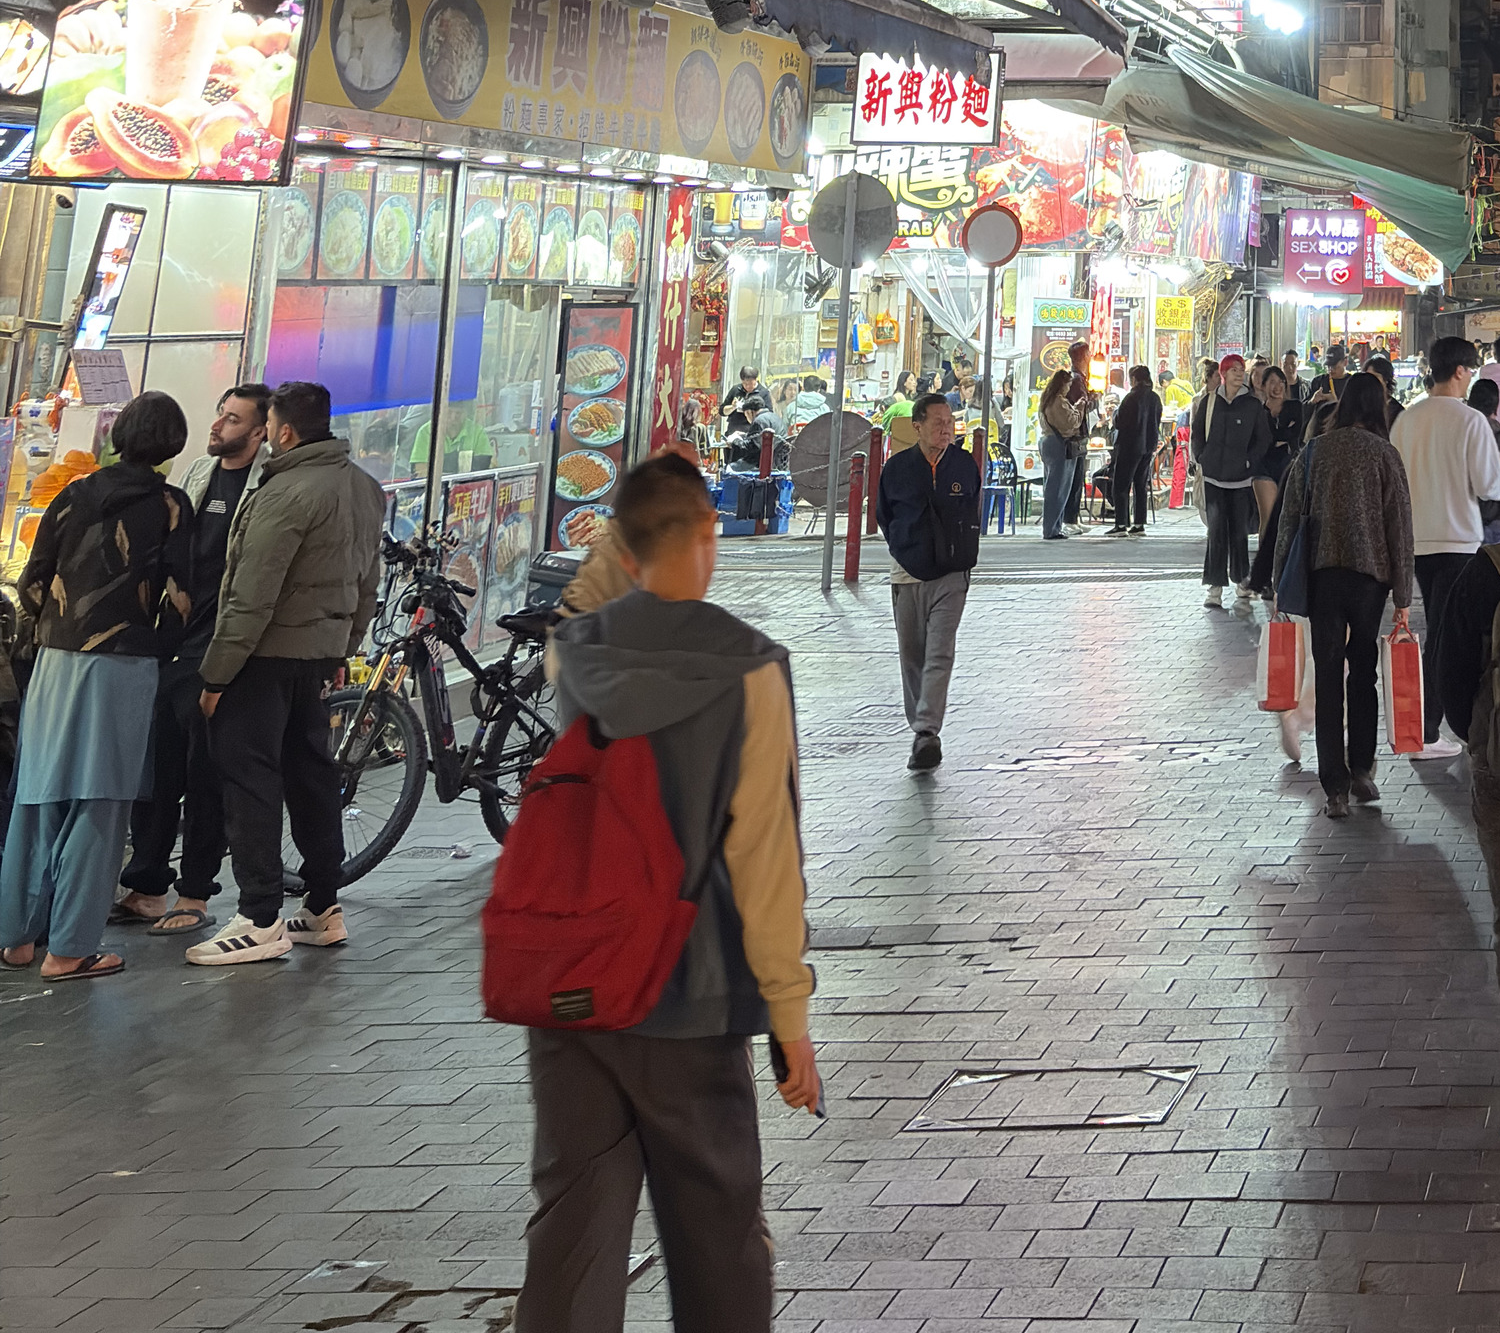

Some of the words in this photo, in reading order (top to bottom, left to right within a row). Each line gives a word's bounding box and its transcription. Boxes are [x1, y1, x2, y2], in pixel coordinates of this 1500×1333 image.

[860, 67, 991, 128] 新興粉麵
[894, 220, 933, 237] RAB
[1290, 217, 1361, 239] 成人用品
[1290, 241, 1317, 254] SEX
[1318, 239, 1359, 256] SHOP
